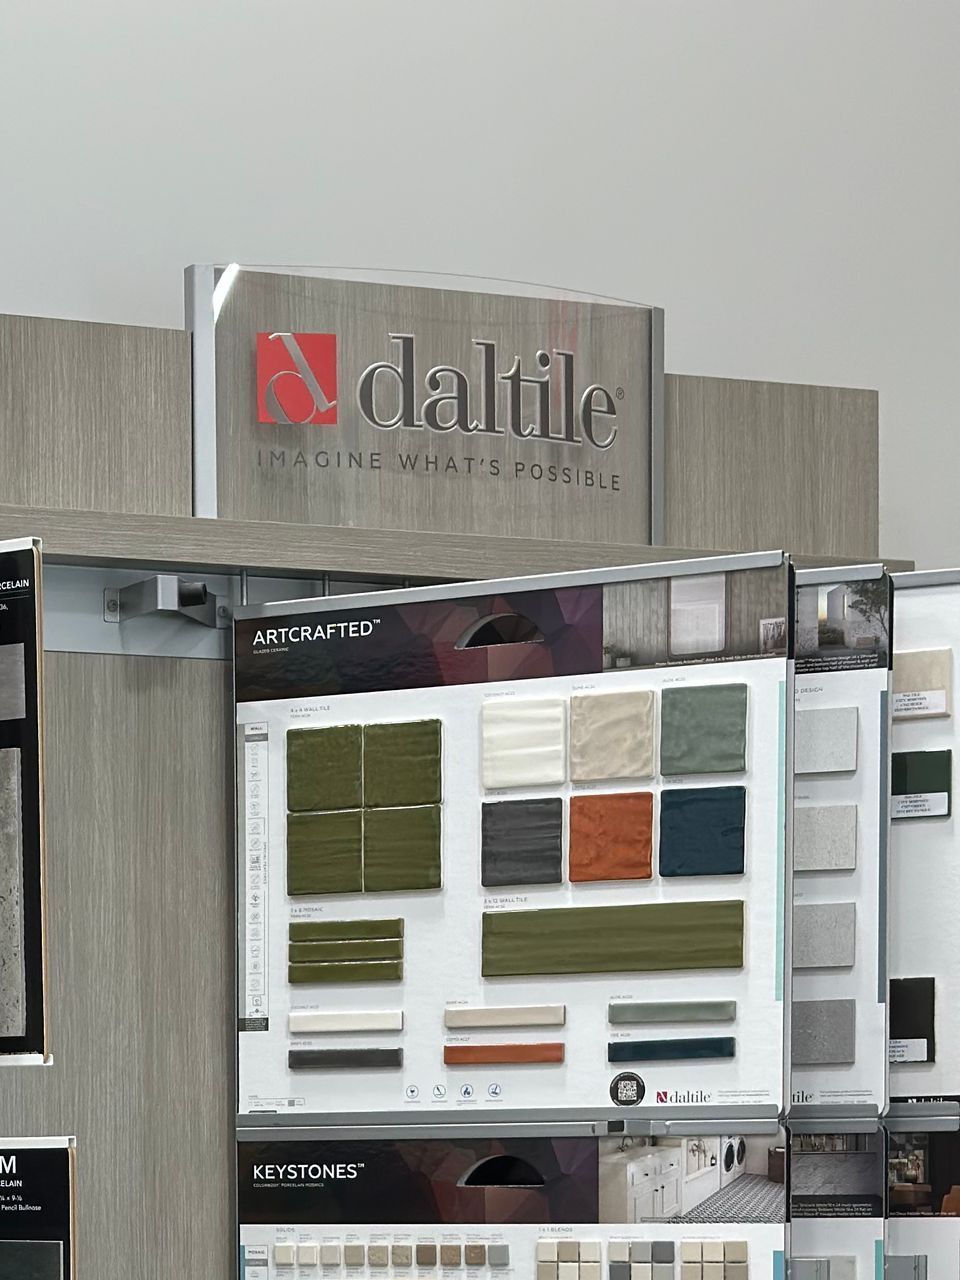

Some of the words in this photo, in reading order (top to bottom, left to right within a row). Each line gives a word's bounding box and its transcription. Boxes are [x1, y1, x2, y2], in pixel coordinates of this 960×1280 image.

[357, 333, 618, 450] daltile
[258, 450, 382, 469] IMAGINE
[399, 453, 500, 476] WHAT'S
[515, 462, 621, 491] POSSIBLE
[669, 1090, 710, 1104] daltile
